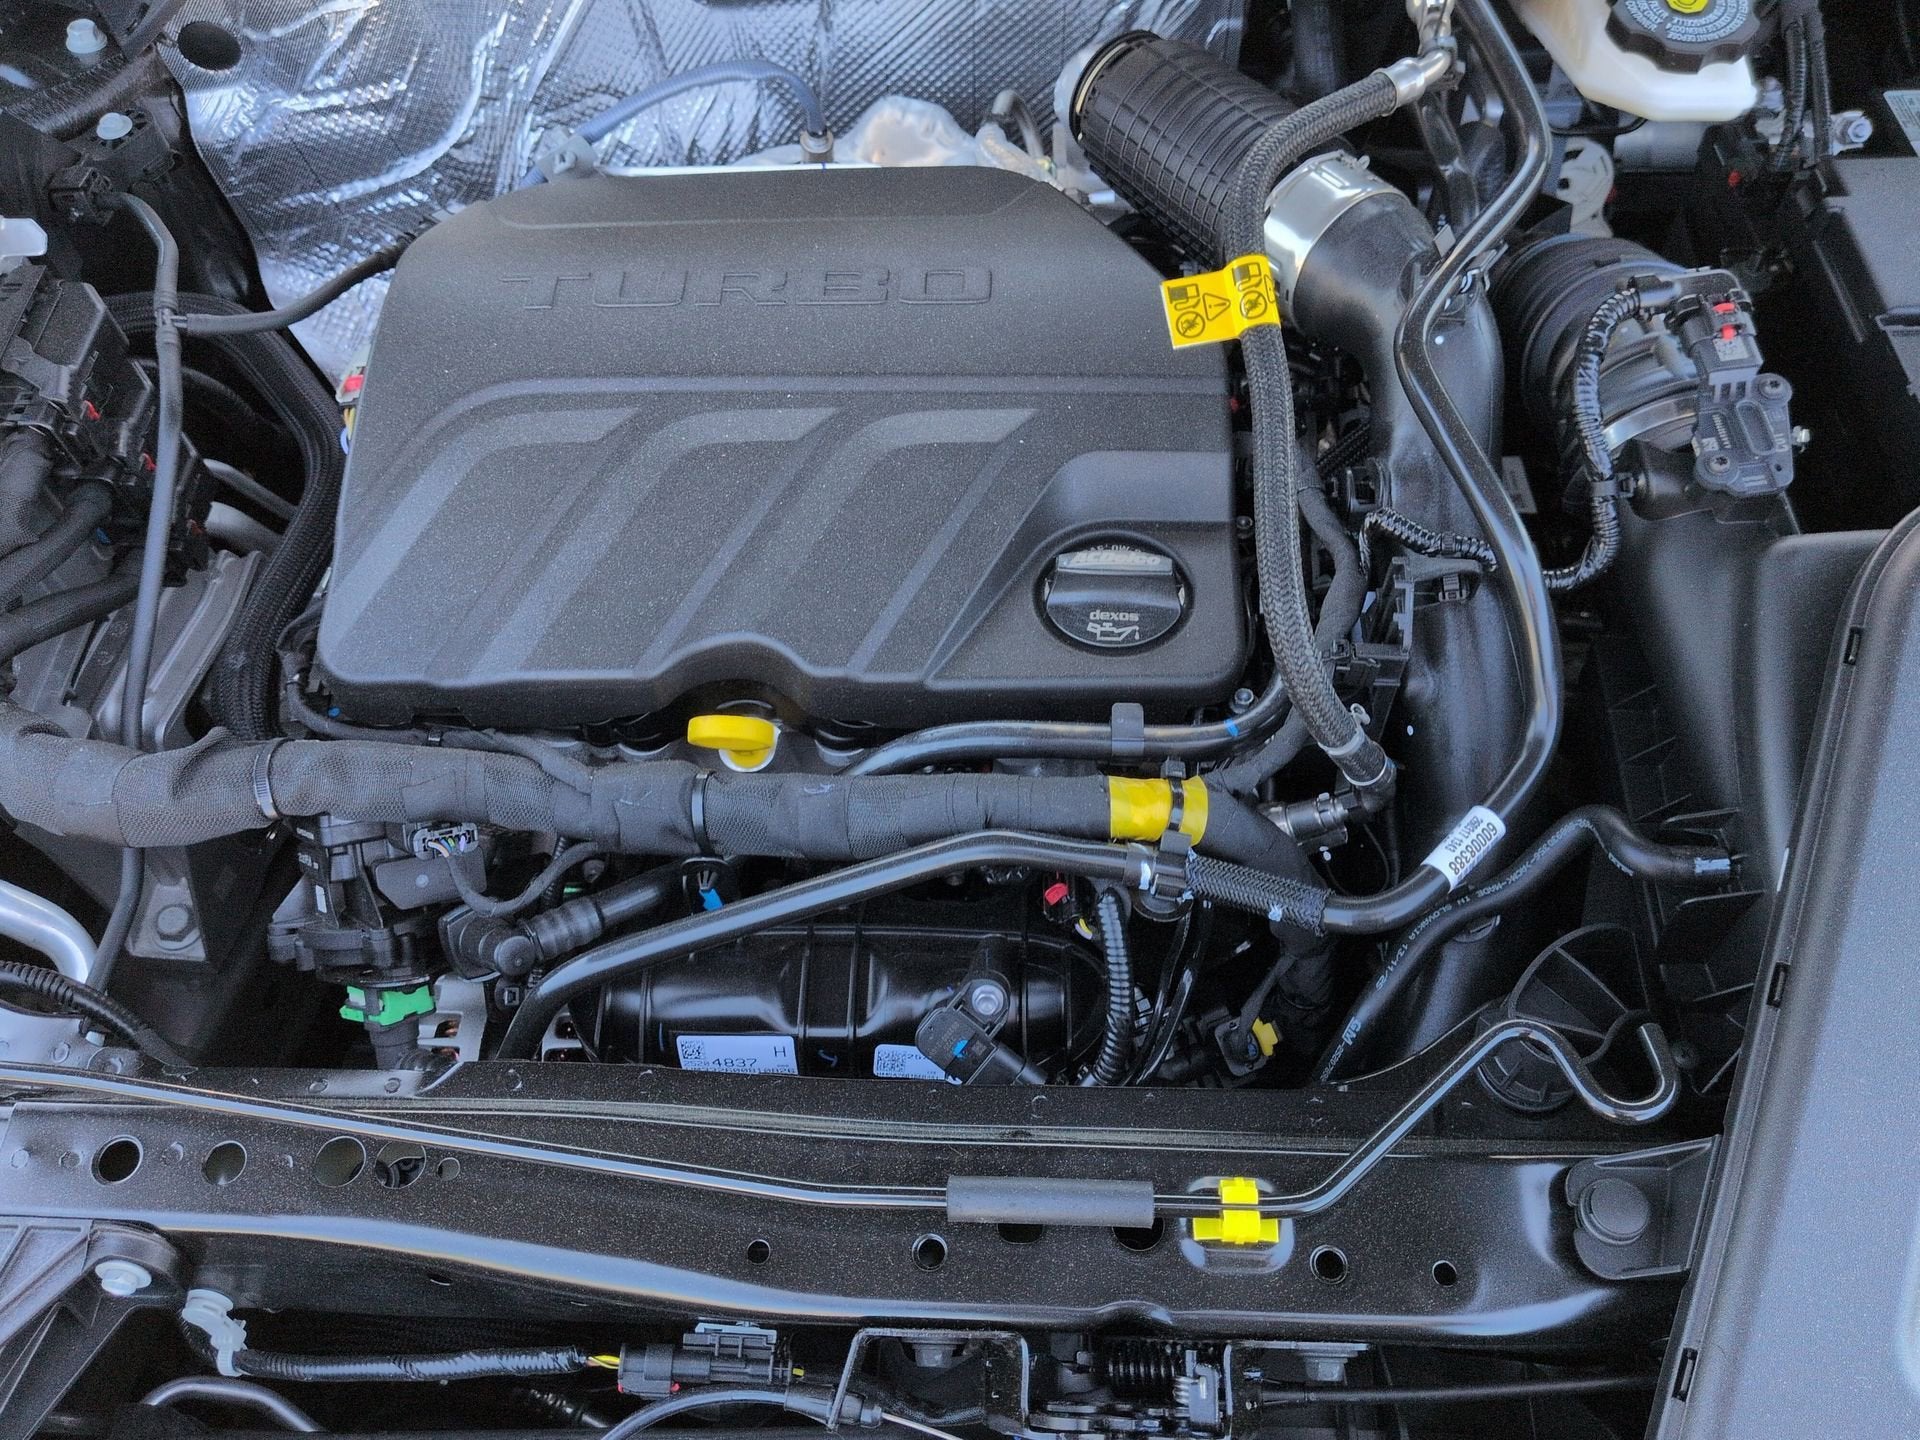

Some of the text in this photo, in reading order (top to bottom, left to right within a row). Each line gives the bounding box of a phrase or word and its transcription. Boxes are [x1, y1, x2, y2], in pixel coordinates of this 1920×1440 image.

[498, 267, 993, 309] TURBO
[1089, 609, 1140, 622] dexos
[1448, 822, 1498, 875] 60008388
[1409, 903, 1453, 941] SLOVAKIA
[772, 1045, 788, 1058] H
